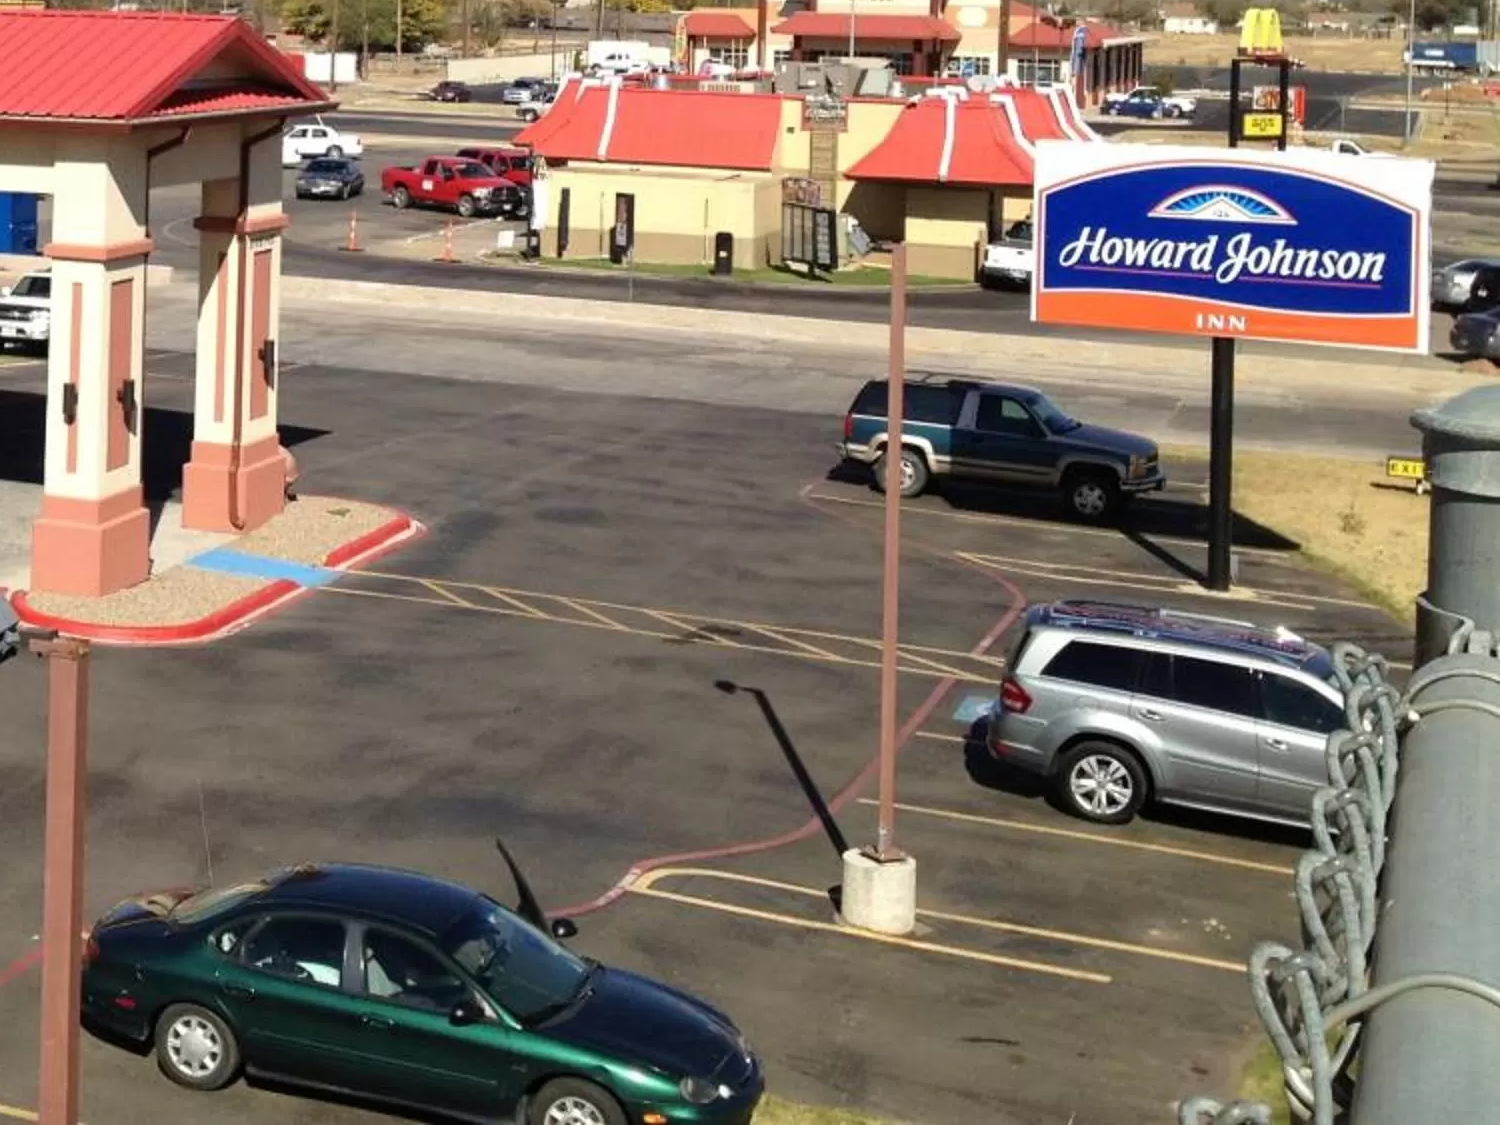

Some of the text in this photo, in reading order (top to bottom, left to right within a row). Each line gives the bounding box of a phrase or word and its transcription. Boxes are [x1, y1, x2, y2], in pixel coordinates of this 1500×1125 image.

[1059, 226, 1386, 284] Howard Johnson
[1196, 313, 1246, 332] INN
